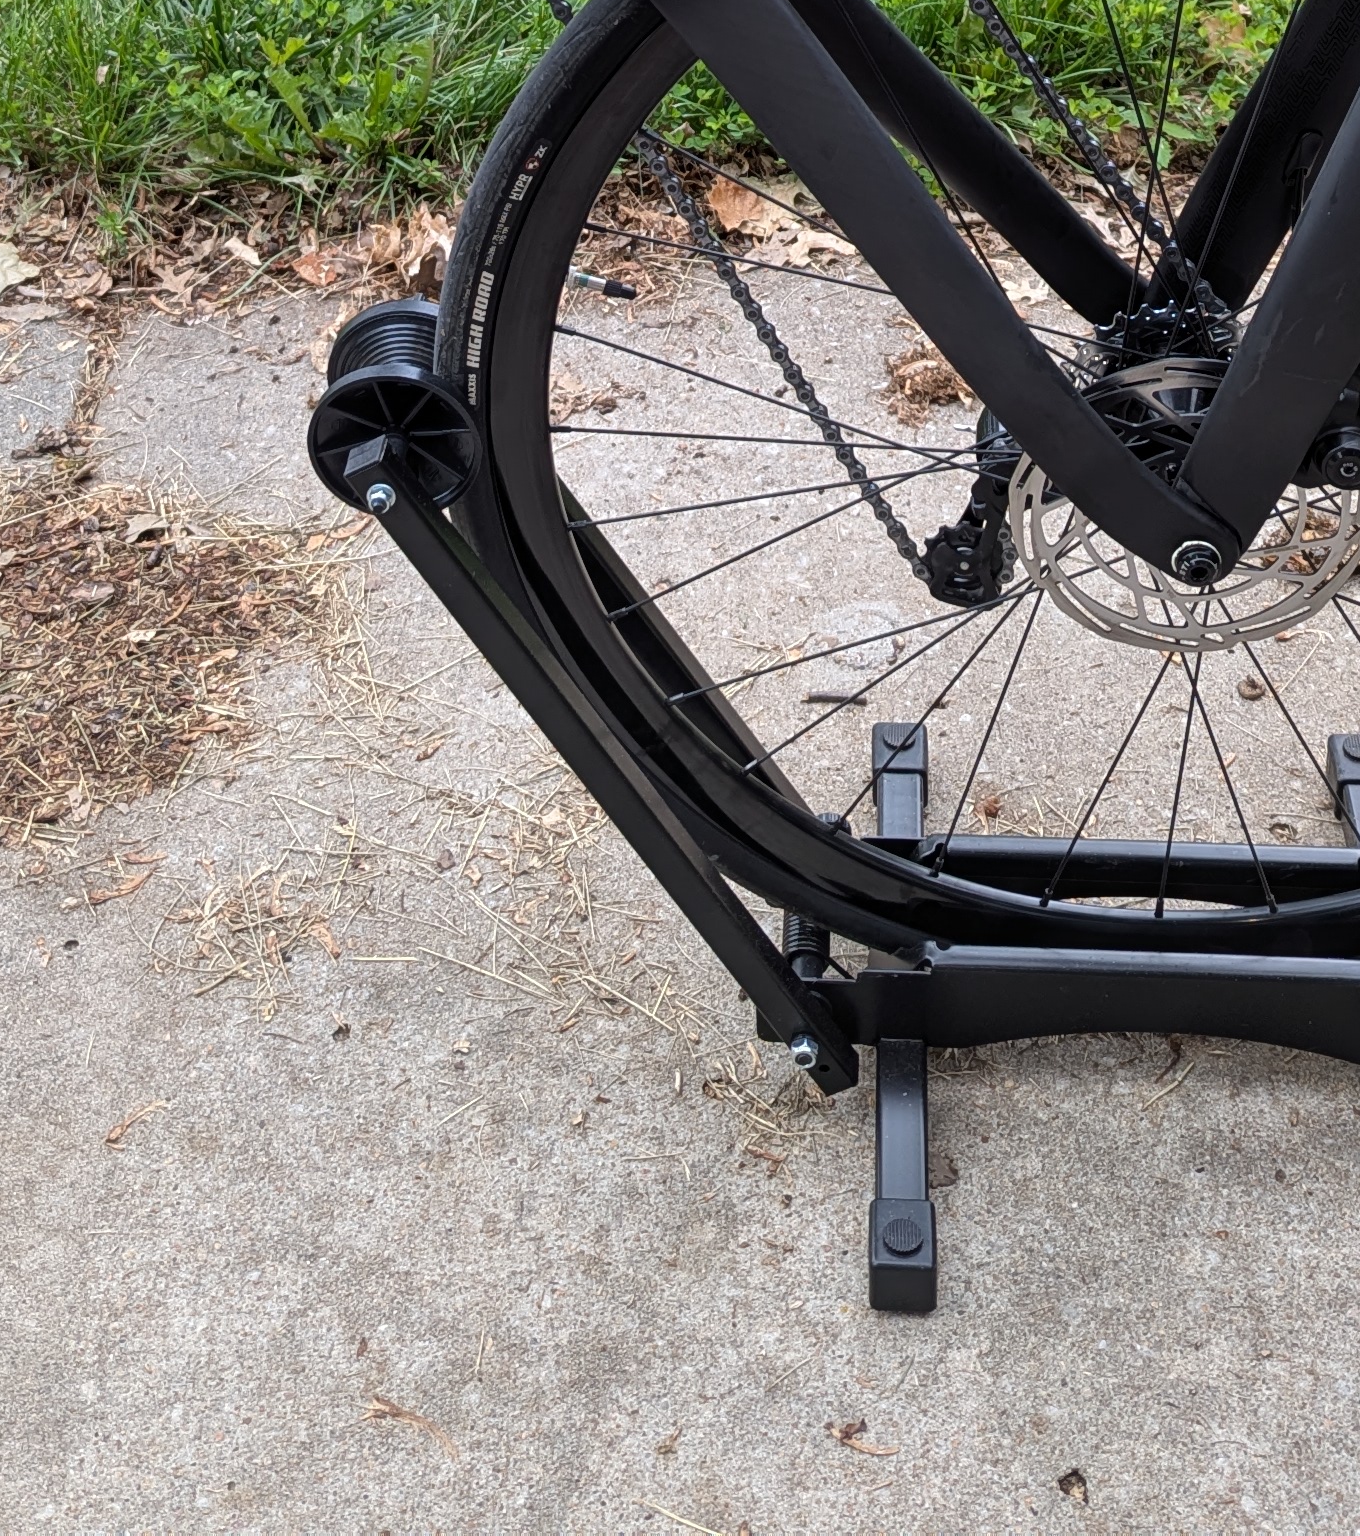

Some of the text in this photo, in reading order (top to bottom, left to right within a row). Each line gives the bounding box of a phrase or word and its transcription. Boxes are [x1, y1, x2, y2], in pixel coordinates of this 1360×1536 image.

[509, 173, 531, 200] HYPR
[472, 271, 495, 322] ROAD
[466, 324, 484, 368] HIGH
